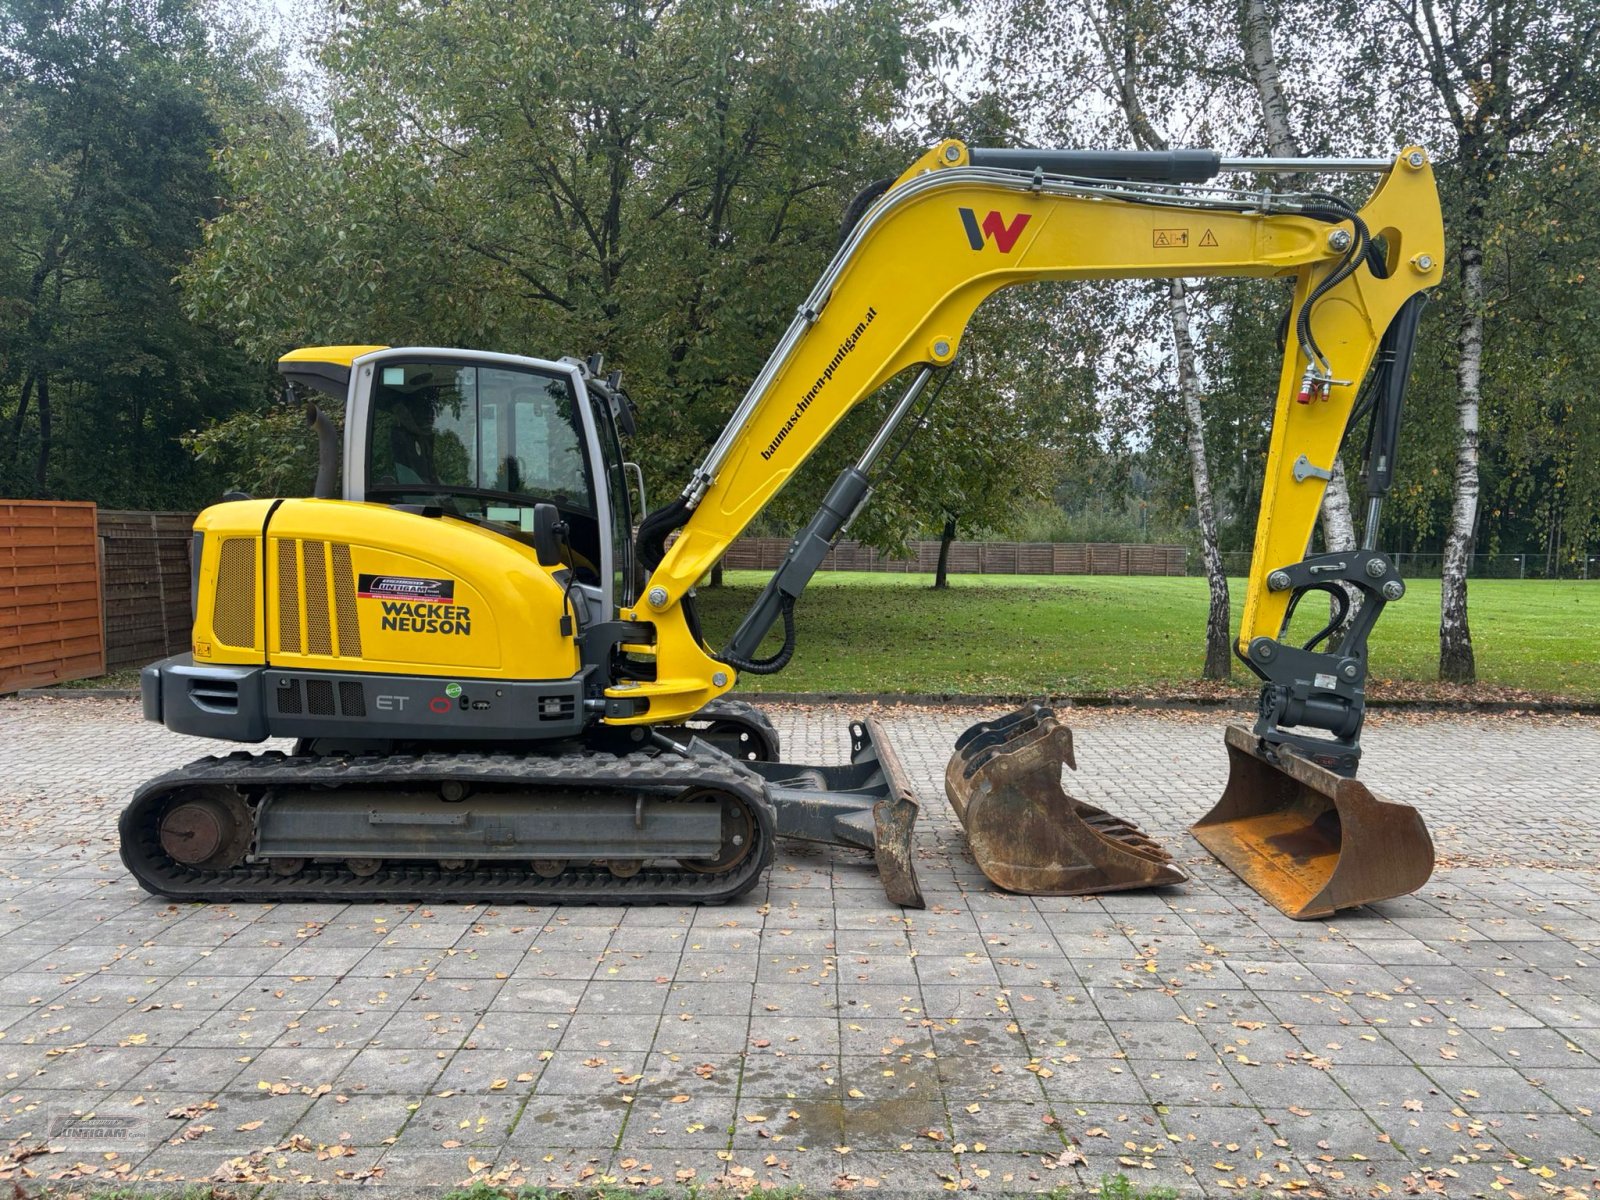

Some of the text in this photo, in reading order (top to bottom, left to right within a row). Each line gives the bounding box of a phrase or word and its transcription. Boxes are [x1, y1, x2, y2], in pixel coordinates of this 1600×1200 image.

[760, 306, 878, 461] baumaschinen-puntigam.at
[381, 601, 471, 621] WACKER
[381, 616, 471, 636] NEUSON
[376, 695, 410, 711] ET
